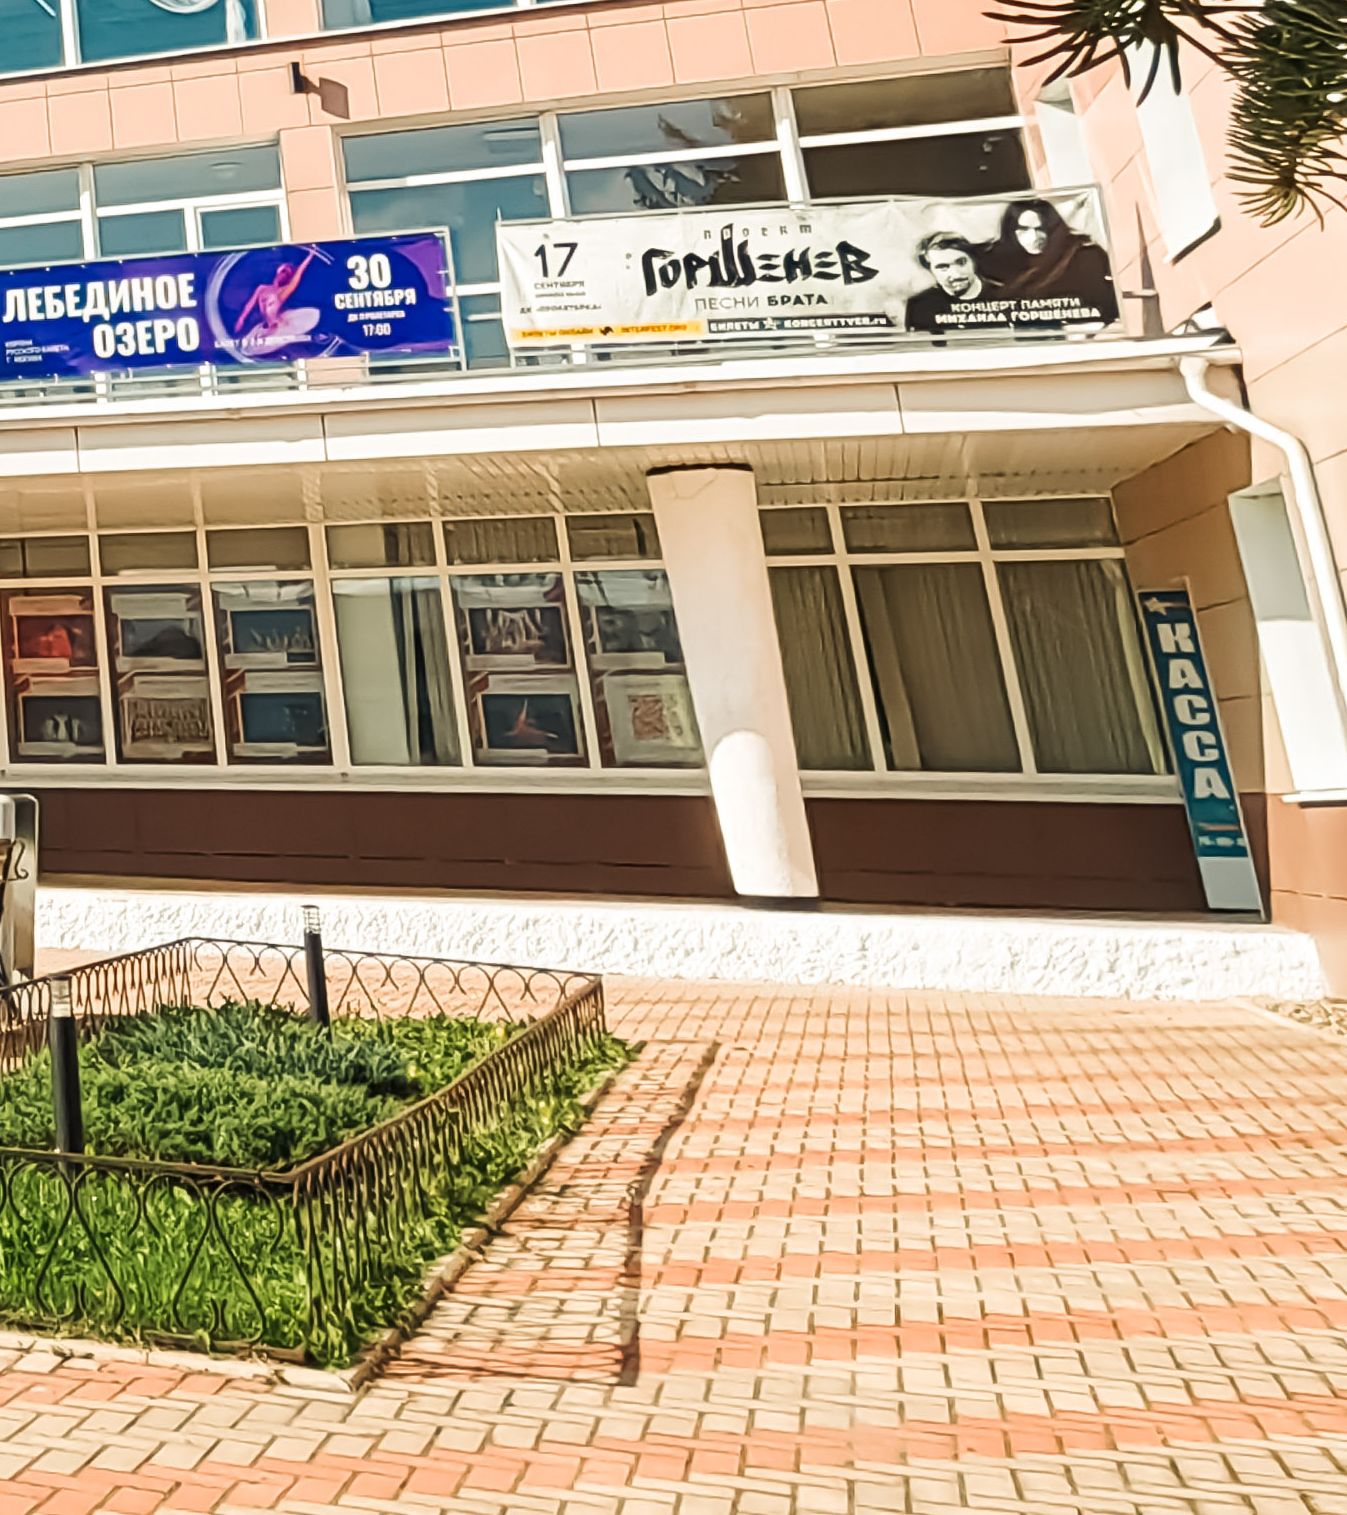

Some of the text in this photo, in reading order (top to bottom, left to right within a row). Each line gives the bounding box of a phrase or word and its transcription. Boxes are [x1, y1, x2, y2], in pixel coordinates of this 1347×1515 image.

[346, 253, 392, 291] 30
[534, 243, 578, 278] 17
[2, 273, 197, 323] ЛЕБЕДИНОЕ
[334, 287, 417, 311] СЕНТЯБРЯ
[694, 293, 829, 311] ПЕСНИ БРАТА
[950, 297, 1081, 313] КОНЦЕРТ ПАМЯТИ
[934, 311, 1007, 325] МИХАИЛА
[92, 317, 200, 359] ОЗЕРО
[1156, 622, 1231, 800] КАССА
